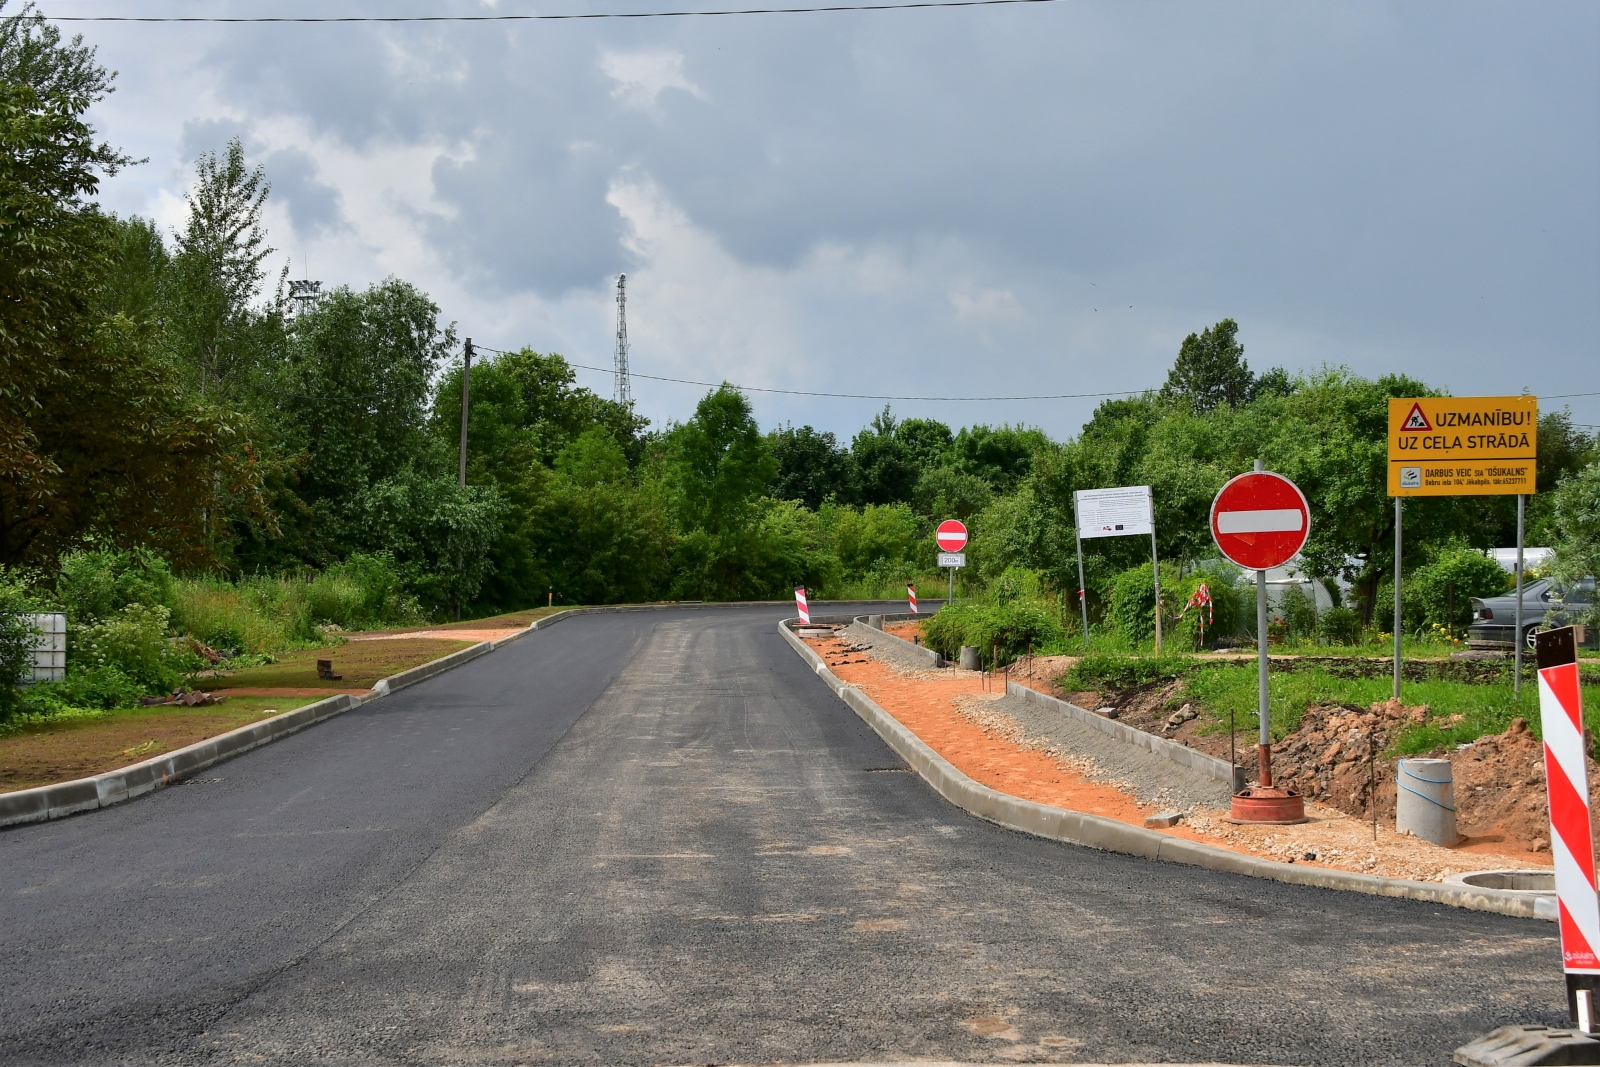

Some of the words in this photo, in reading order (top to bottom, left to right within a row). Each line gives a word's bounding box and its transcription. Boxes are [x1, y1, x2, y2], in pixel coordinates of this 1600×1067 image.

[1436, 409, 1530, 427] UZMANĪBU!
[1398, 437, 1418, 450] UZ
[1422, 436, 1463, 454] CEĻA
[1467, 433, 1530, 449] STRĀDĀ
[1425, 468, 1454, 478] DARBUS
[1456, 468, 1472, 477] VEIC
